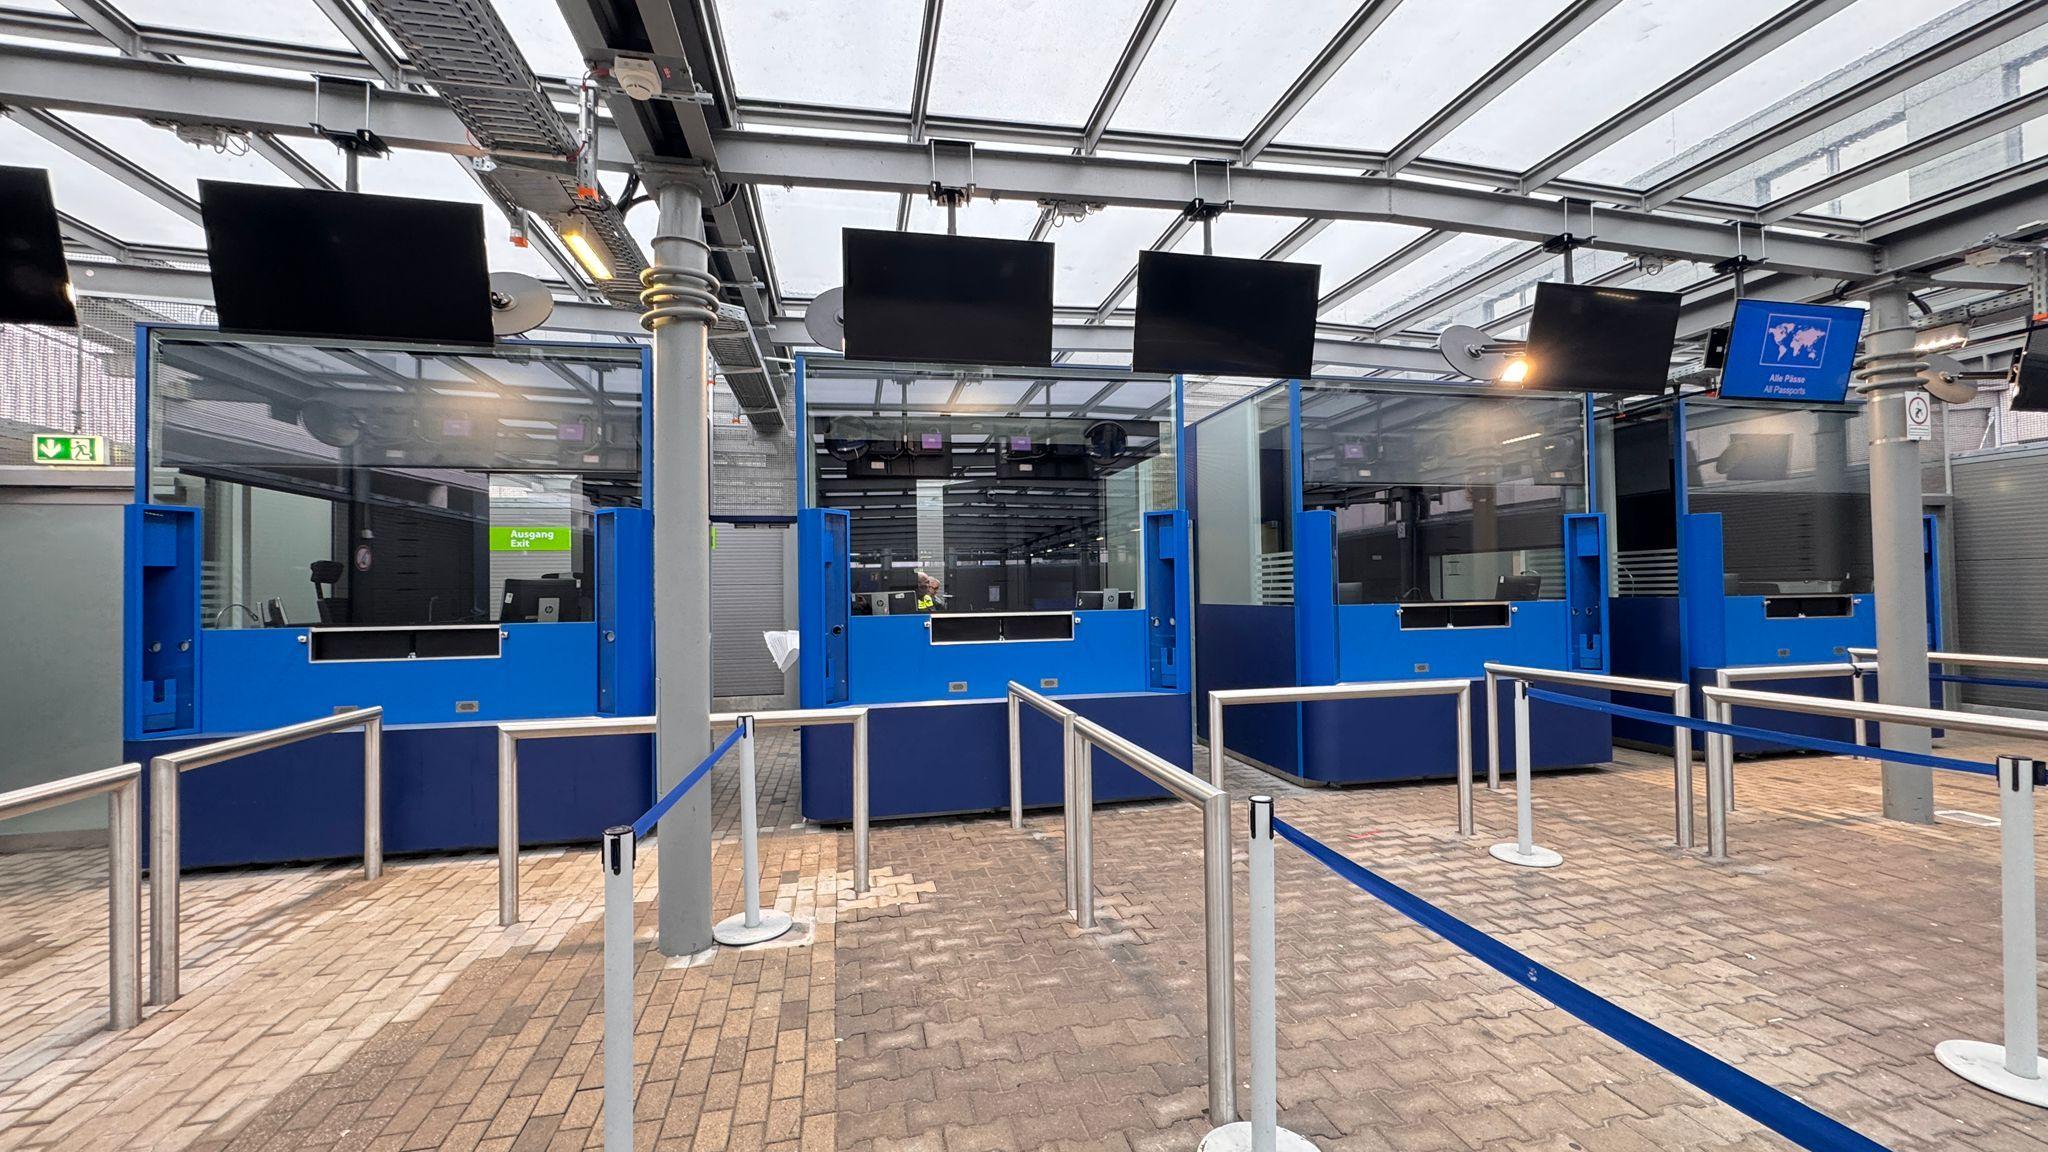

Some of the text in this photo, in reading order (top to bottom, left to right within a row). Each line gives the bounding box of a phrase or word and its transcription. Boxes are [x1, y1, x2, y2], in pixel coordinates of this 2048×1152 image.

[1769, 374, 1806, 383] Alle Pässe
[1763, 385, 1806, 396] All Passports
[510, 529, 554, 540] Ausgang
[510, 539, 530, 547] Exit
